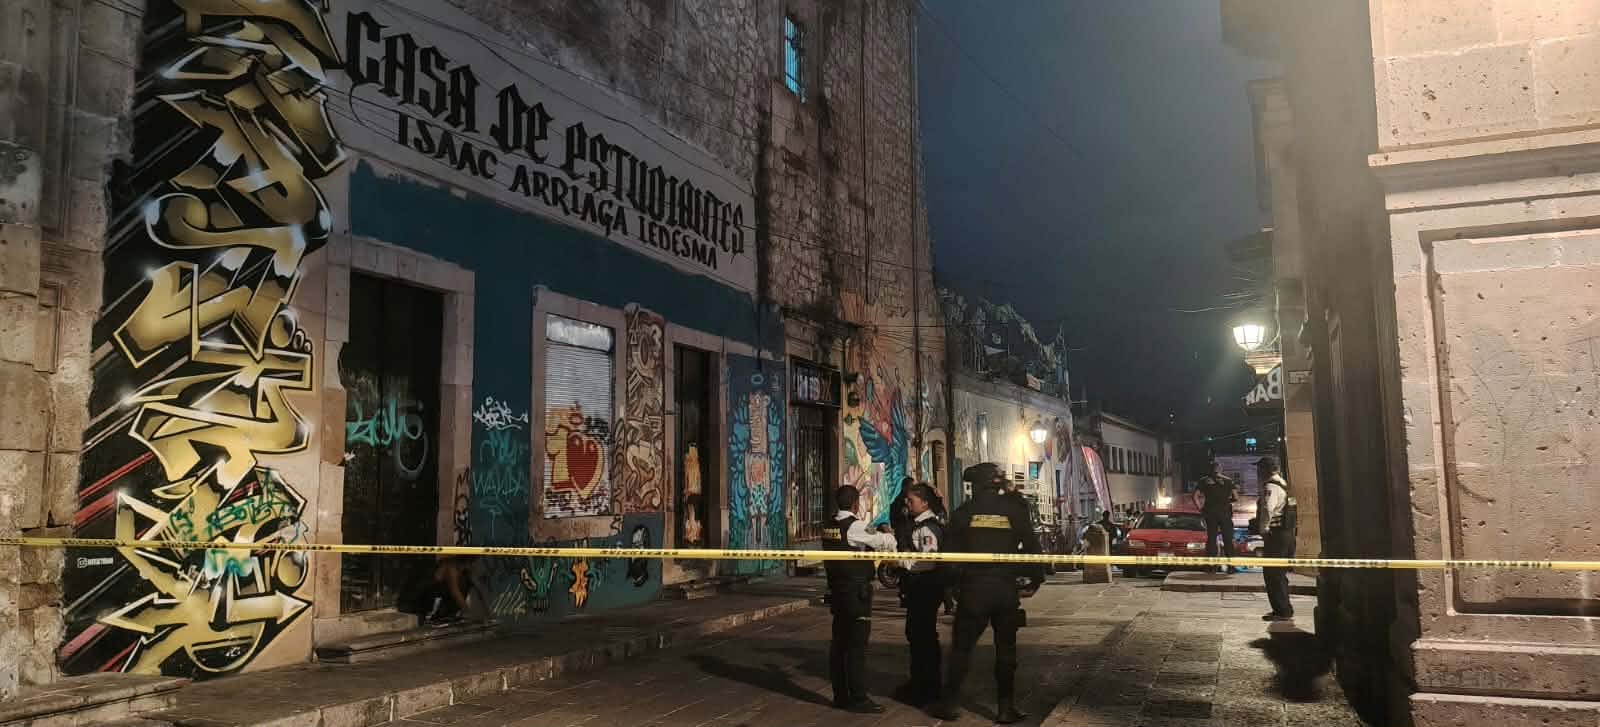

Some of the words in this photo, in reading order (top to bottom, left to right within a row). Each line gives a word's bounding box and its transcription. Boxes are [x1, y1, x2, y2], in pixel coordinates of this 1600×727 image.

[346, 12, 480, 133] CASA
[398, 112, 497, 179] ISAAC
[508, 164, 628, 237] ARRIAGA
[638, 216, 717, 269] LEDESMA
